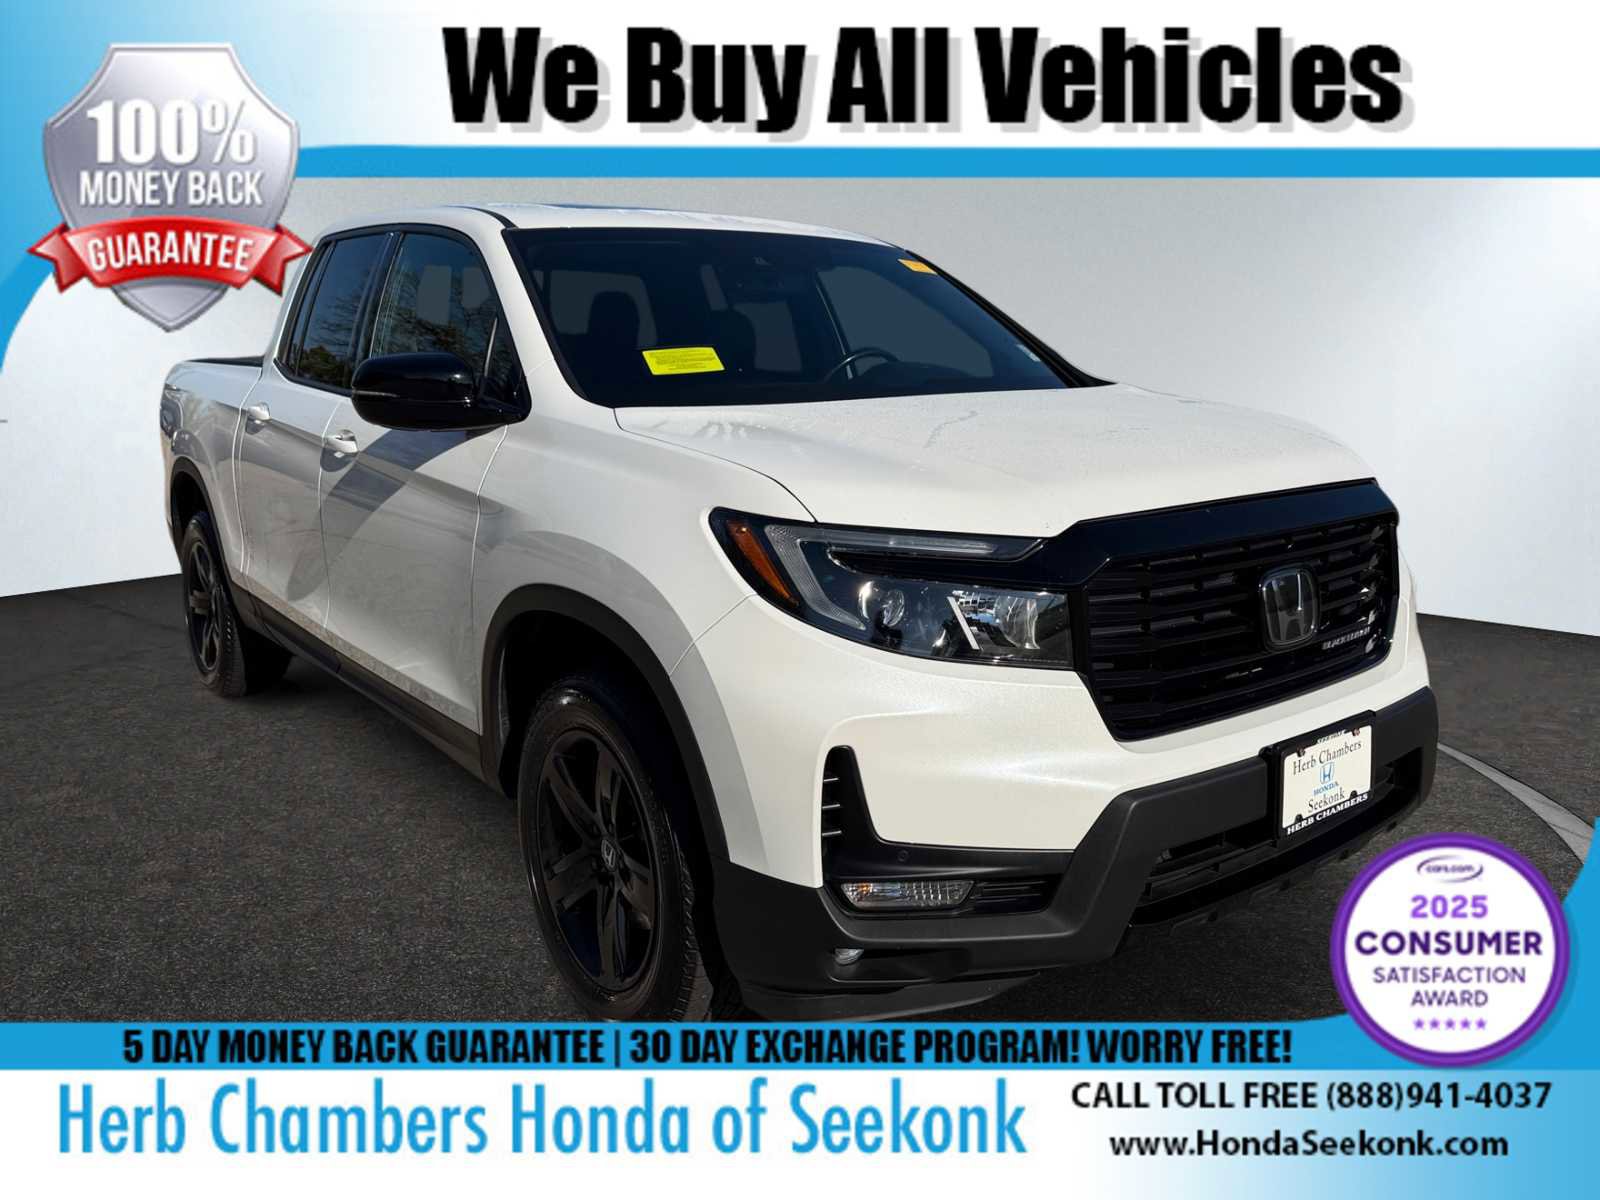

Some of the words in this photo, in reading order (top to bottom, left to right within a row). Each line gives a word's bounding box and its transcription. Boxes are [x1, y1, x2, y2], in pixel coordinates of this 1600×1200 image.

[1292, 755, 1317, 775] Herb
[1318, 740, 1362, 764] Chambers
[1307, 787, 1346, 813] Seekonk
[1313, 781, 1339, 796] HONDA
[1287, 816, 1315, 836] HERB
[1315, 793, 1369, 821] CHAMBERS
